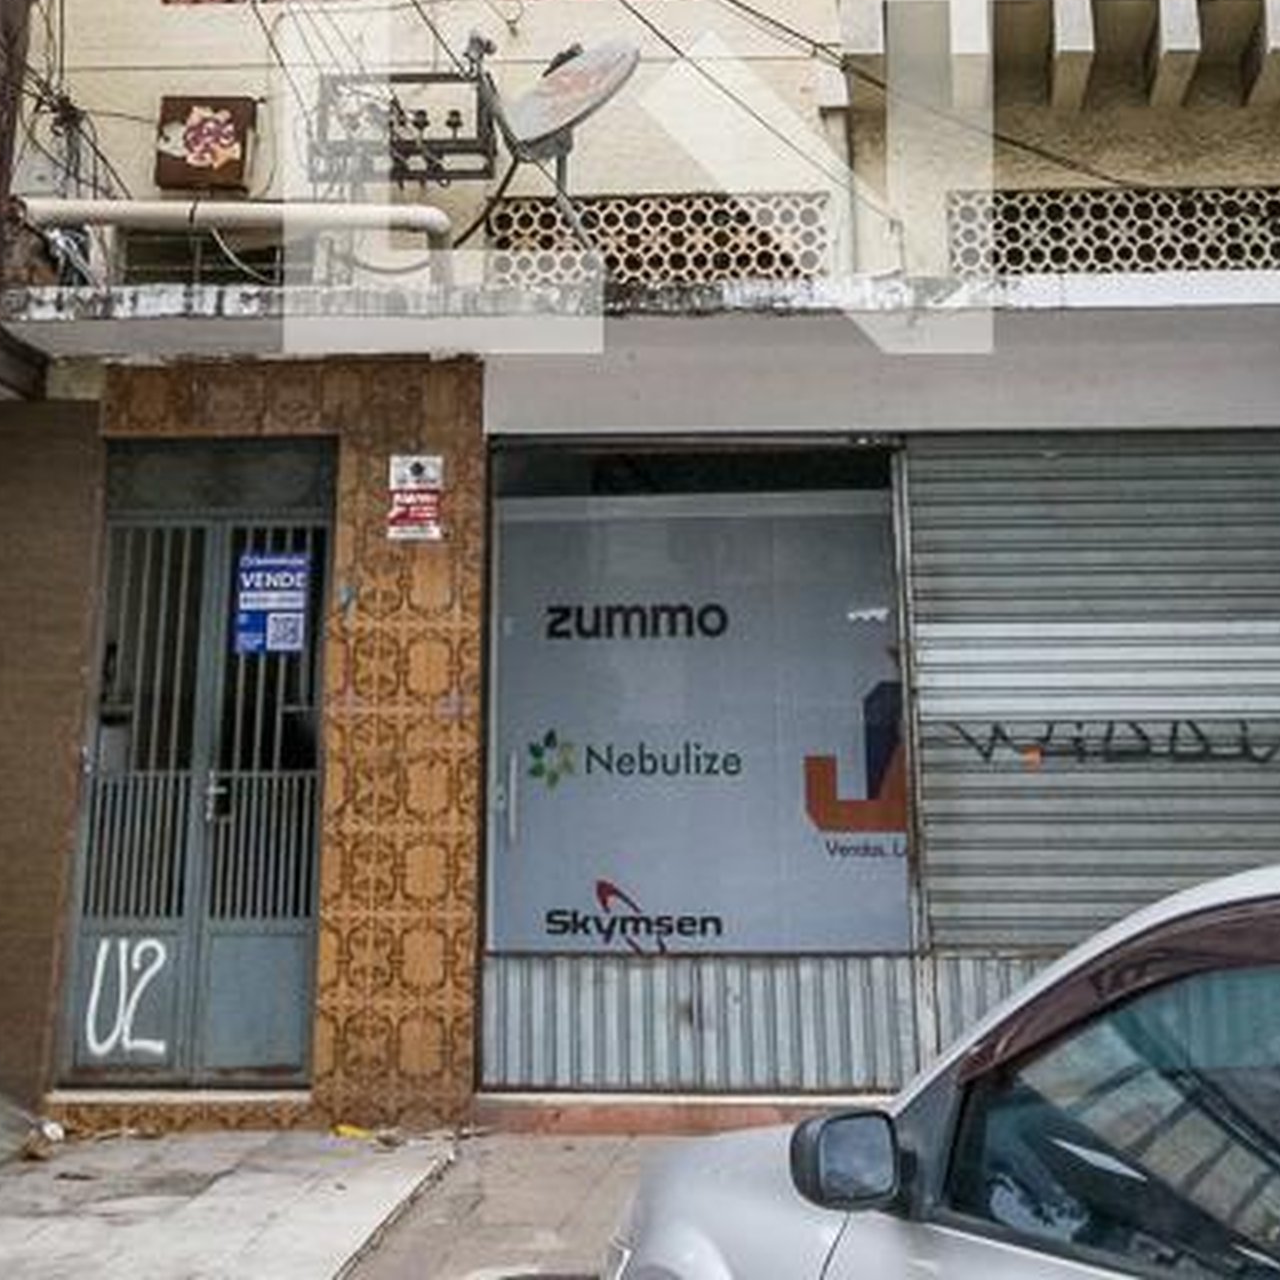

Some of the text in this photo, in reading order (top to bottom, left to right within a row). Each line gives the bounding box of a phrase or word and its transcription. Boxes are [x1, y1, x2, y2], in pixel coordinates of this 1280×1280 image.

[240, 572, 307, 589] VENDE
[545, 602, 729, 640] zummo
[585, 742, 742, 777] Nebulize
[545, 908, 723, 944] Skymsen
